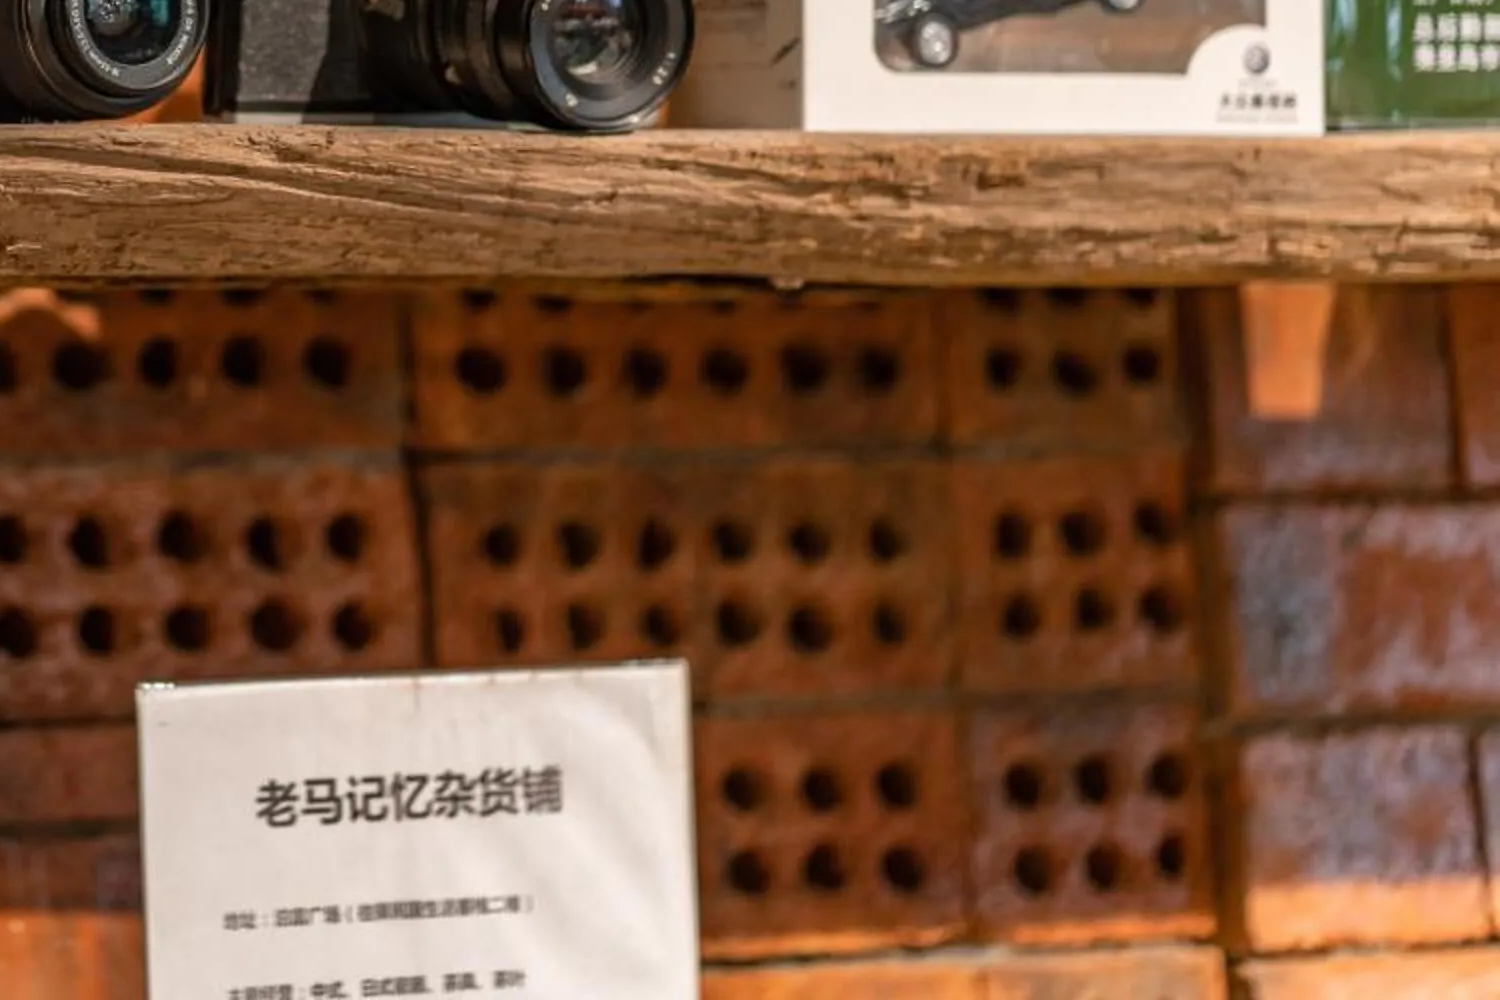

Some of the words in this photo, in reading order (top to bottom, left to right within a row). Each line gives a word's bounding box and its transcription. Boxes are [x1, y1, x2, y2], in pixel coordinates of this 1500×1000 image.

[256, 766, 563, 827] 老马记忆杂货铺
